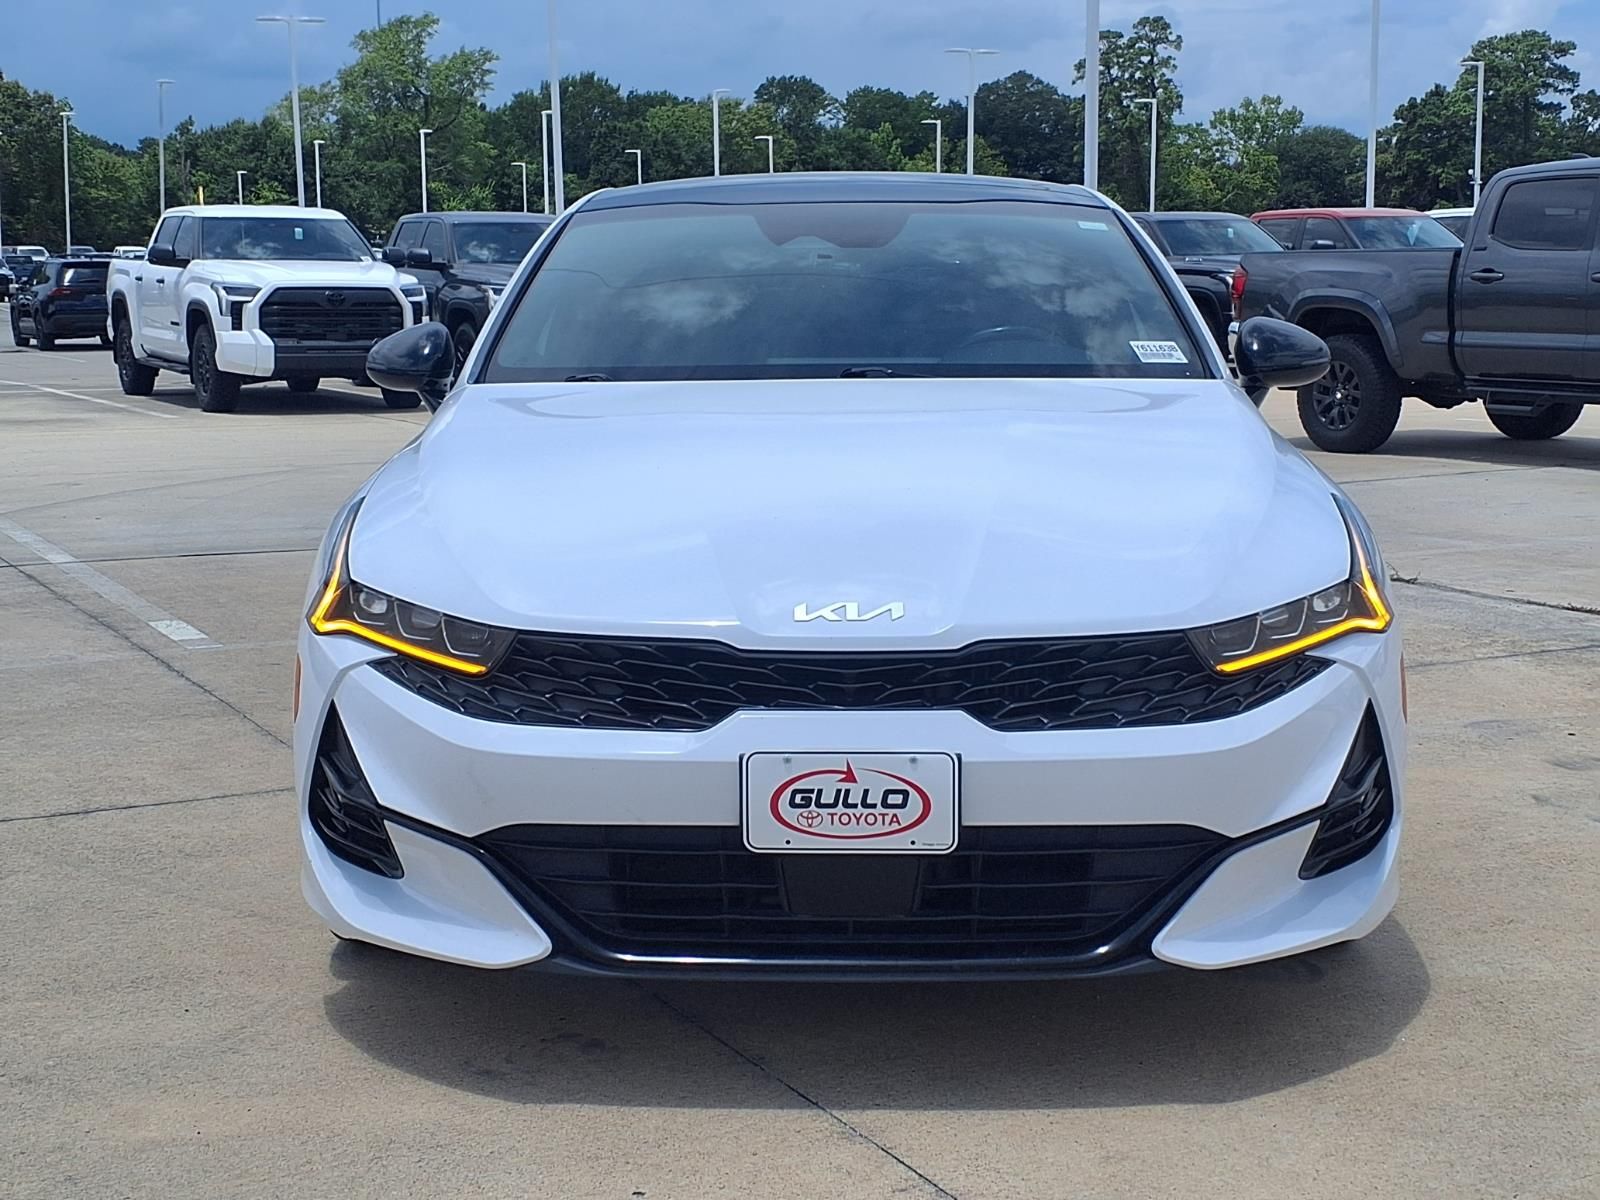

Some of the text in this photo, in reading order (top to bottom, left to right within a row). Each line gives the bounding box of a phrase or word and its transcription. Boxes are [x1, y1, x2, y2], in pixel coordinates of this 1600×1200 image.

[793, 601, 905, 622] KIA
[788, 788, 910, 809] GULLO
[827, 812, 902, 827] TOYOTA
